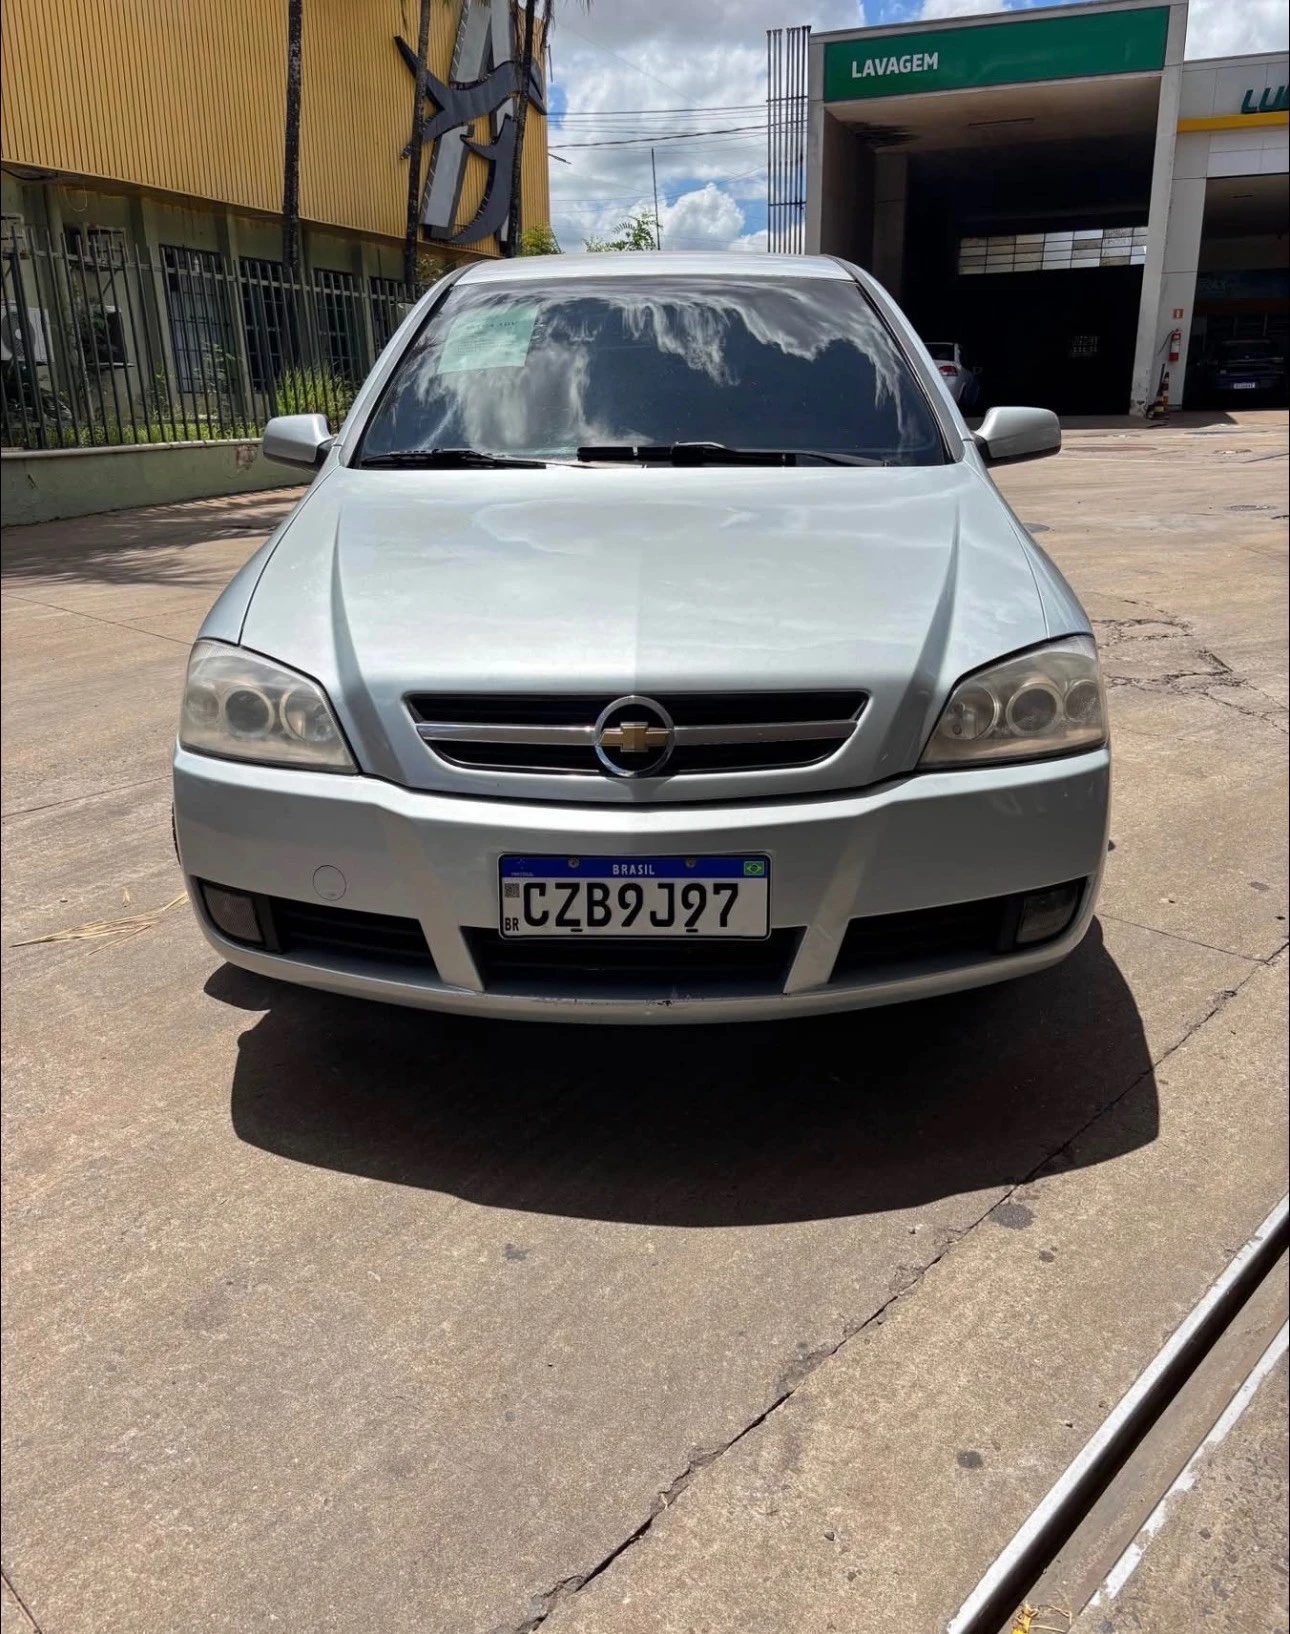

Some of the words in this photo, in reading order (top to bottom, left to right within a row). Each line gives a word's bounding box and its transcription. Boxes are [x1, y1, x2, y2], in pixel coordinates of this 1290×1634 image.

[852, 52, 939, 78] LAVAGEM
[612, 864, 655, 875] BRASIL
[523, 882, 739, 928] CZB9J97
[504, 917, 519, 931] BR
